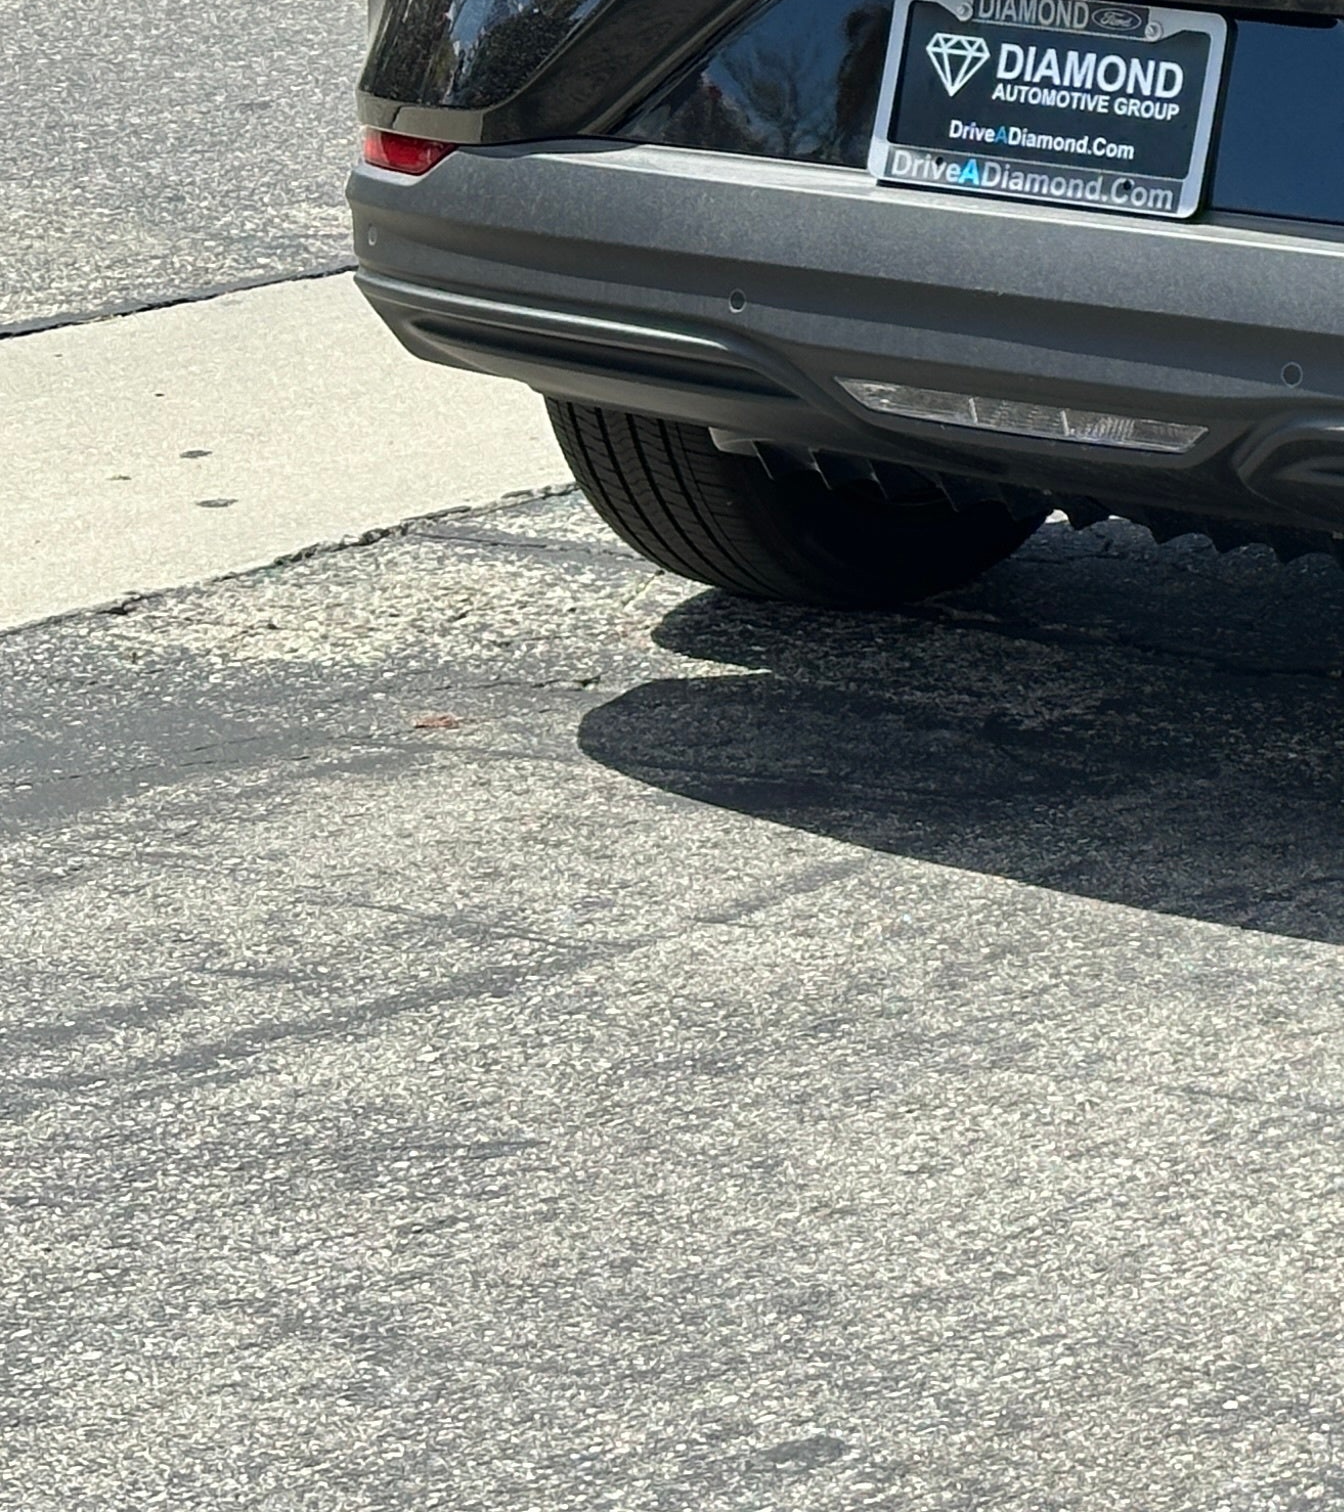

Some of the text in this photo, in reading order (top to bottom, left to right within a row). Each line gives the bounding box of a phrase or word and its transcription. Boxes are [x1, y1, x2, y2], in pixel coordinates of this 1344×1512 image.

[1099, 9, 1138, 29] Ford
[996, 43, 1184, 99] DIAMOND
[991, 82, 1180, 121] AUTOMOTIVE GROUP
[948, 119, 1135, 160] DriveADiamond.Com
[890, 149, 1175, 210] DriveADiamond.Com
